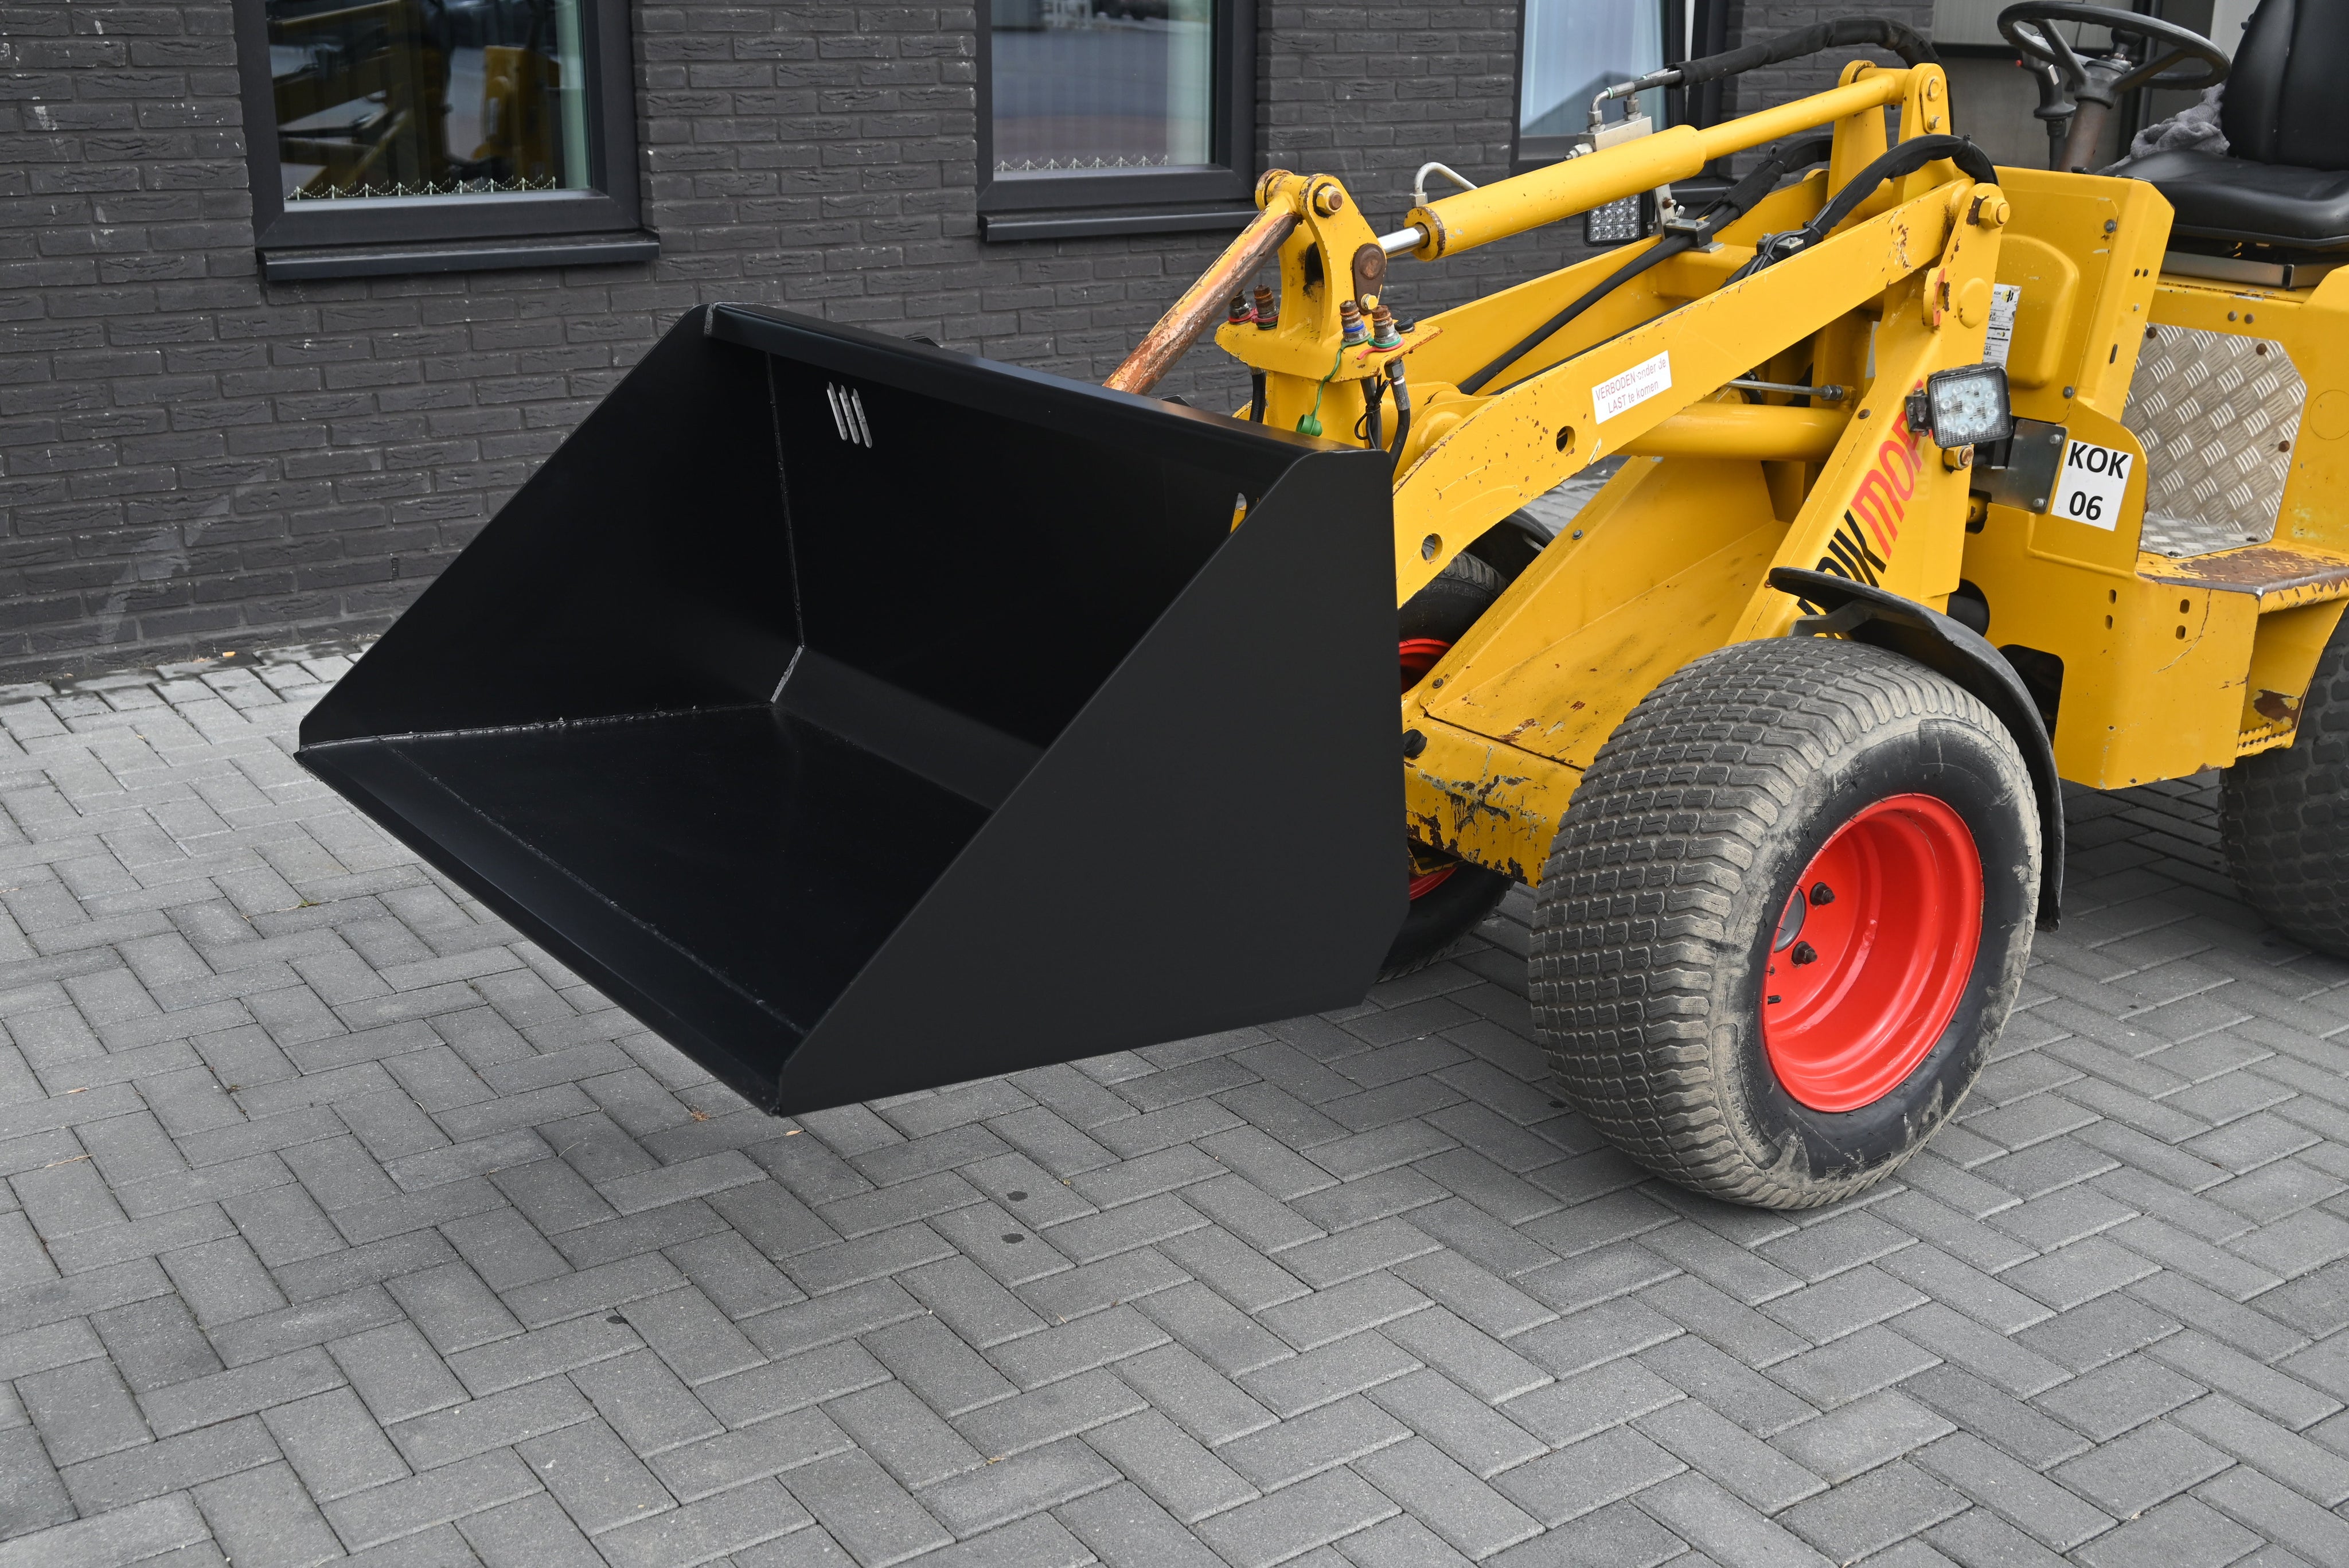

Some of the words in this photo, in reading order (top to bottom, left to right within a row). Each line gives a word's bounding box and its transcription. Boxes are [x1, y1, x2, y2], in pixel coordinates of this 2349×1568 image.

[1595, 373, 1636, 400] VERBODEN
[1636, 362, 1657, 380] onder
[1658, 357, 1667, 370] de
[1608, 394, 1627, 414] LAST
[1628, 392, 1634, 404] te
[1636, 380, 1659, 399] komen
[2068, 442, 2129, 479] KOK
[2069, 491, 2103, 521] 06
